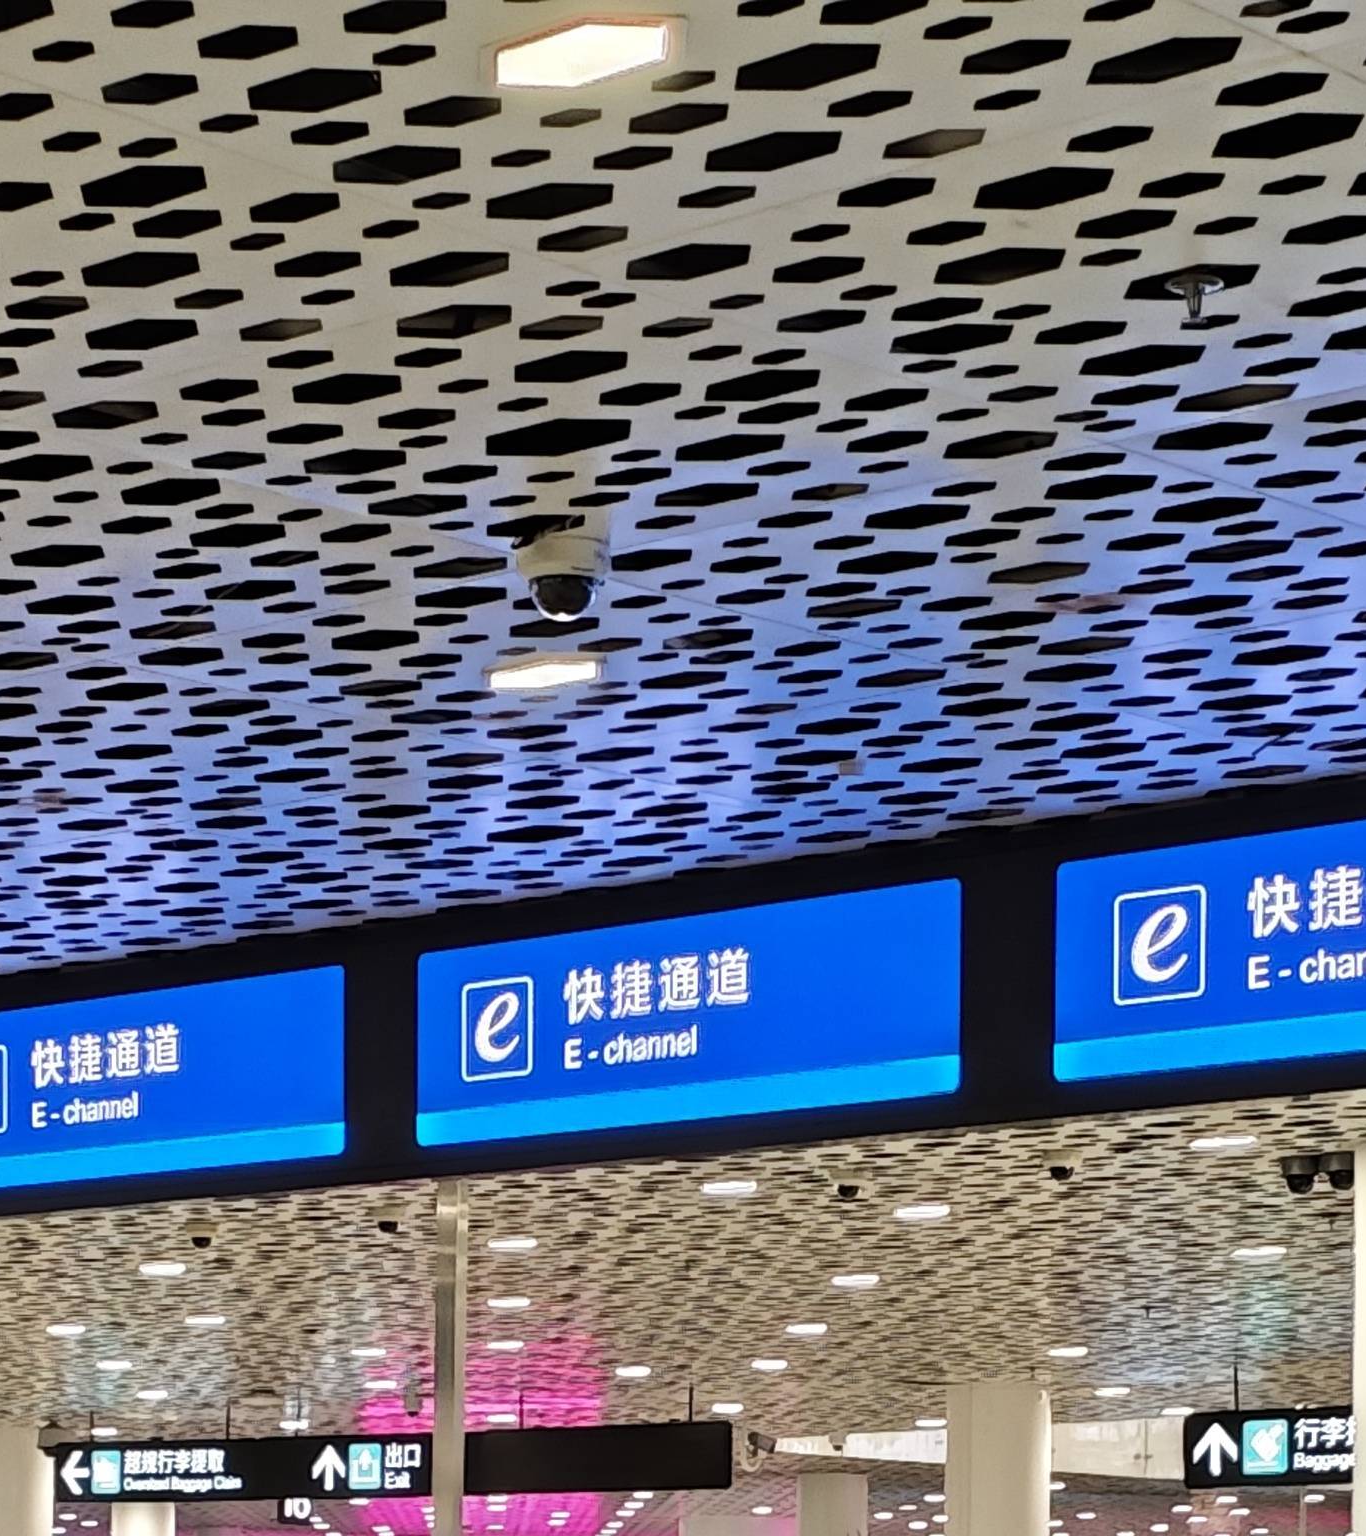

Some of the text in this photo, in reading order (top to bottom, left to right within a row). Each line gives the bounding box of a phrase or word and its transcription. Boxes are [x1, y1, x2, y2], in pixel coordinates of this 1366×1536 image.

[563, 946, 751, 1026] 快捷通道
[31, 1023, 179, 1089] 快捷通道
[385, 1443, 422, 1468] 出口
[385, 1472, 412, 1488] Exit
